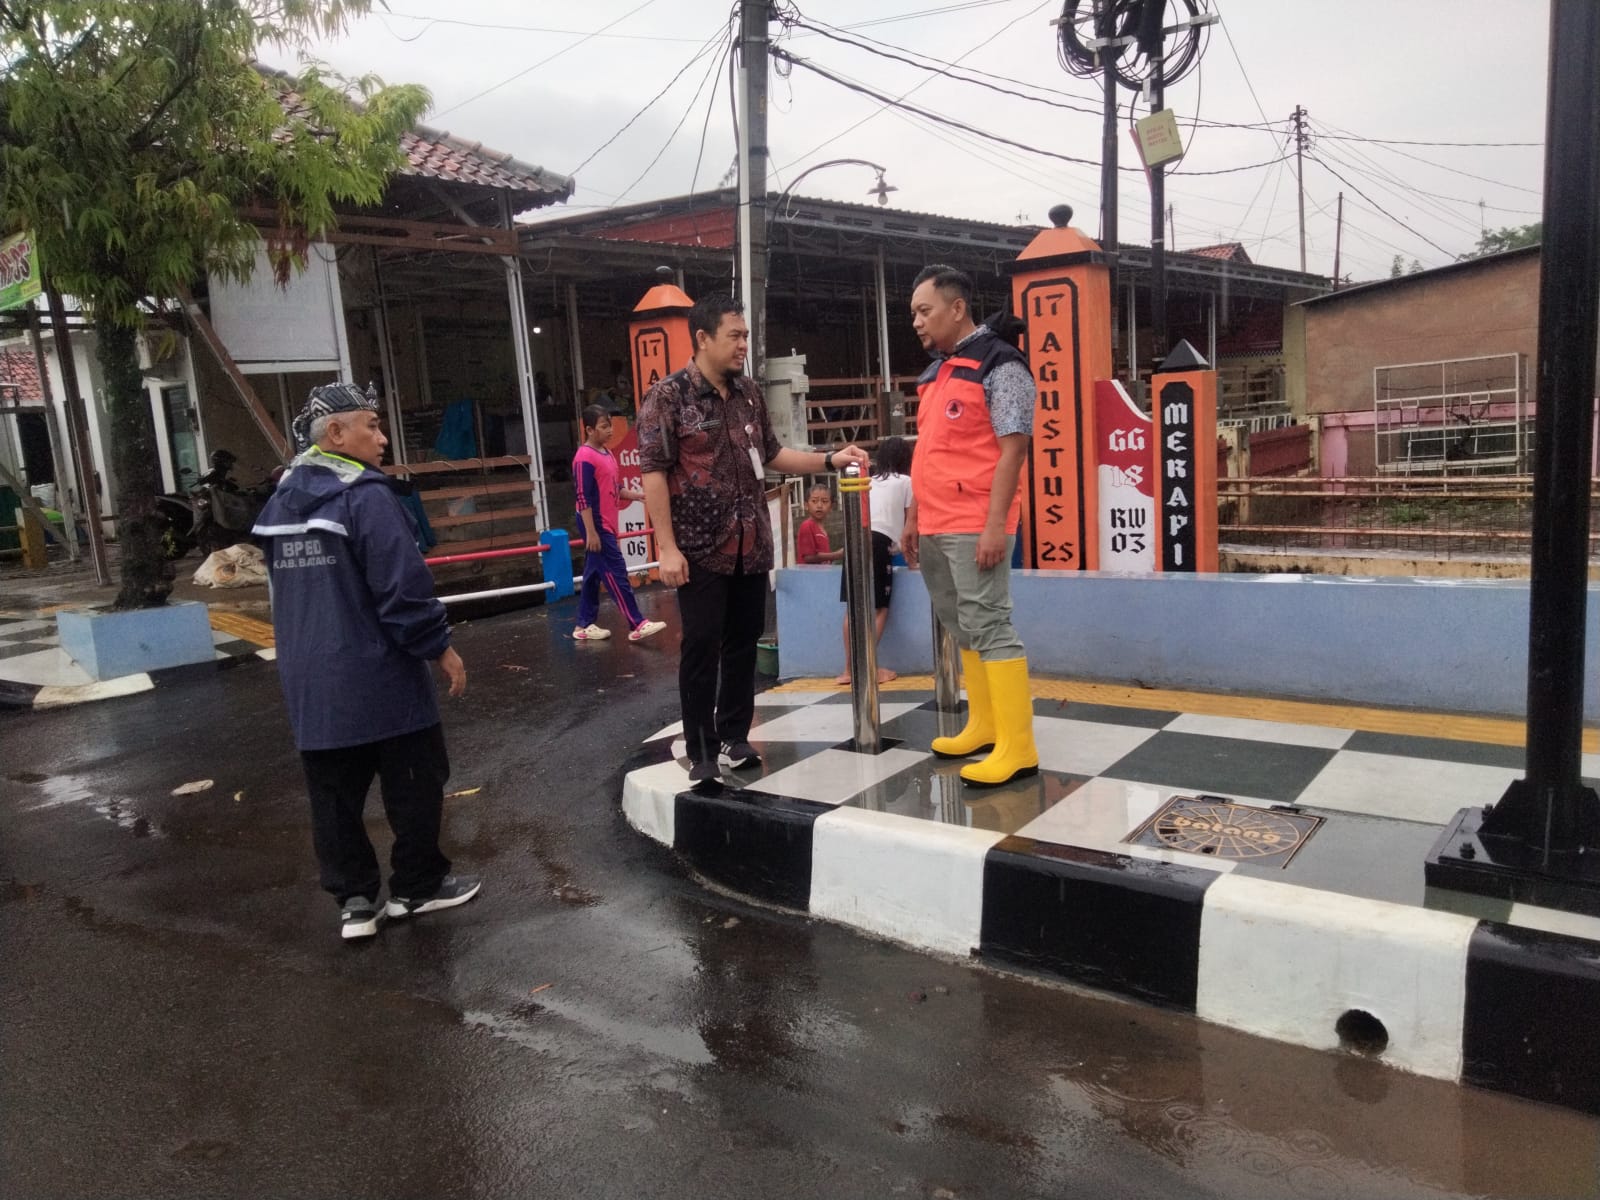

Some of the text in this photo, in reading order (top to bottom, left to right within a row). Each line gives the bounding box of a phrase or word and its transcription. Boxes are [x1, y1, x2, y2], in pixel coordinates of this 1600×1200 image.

[1032, 293, 1065, 317] 17
[642, 339, 662, 358] 17
[1039, 331, 1065, 525] AGUSTUS
[1108, 427, 1145, 452] GG
[1163, 402, 1189, 566] MERAPI
[1110, 507, 1146, 529] RW
[627, 540, 646, 557] 06
[1041, 541, 1074, 562] 25
[1111, 532, 1146, 554] 03
